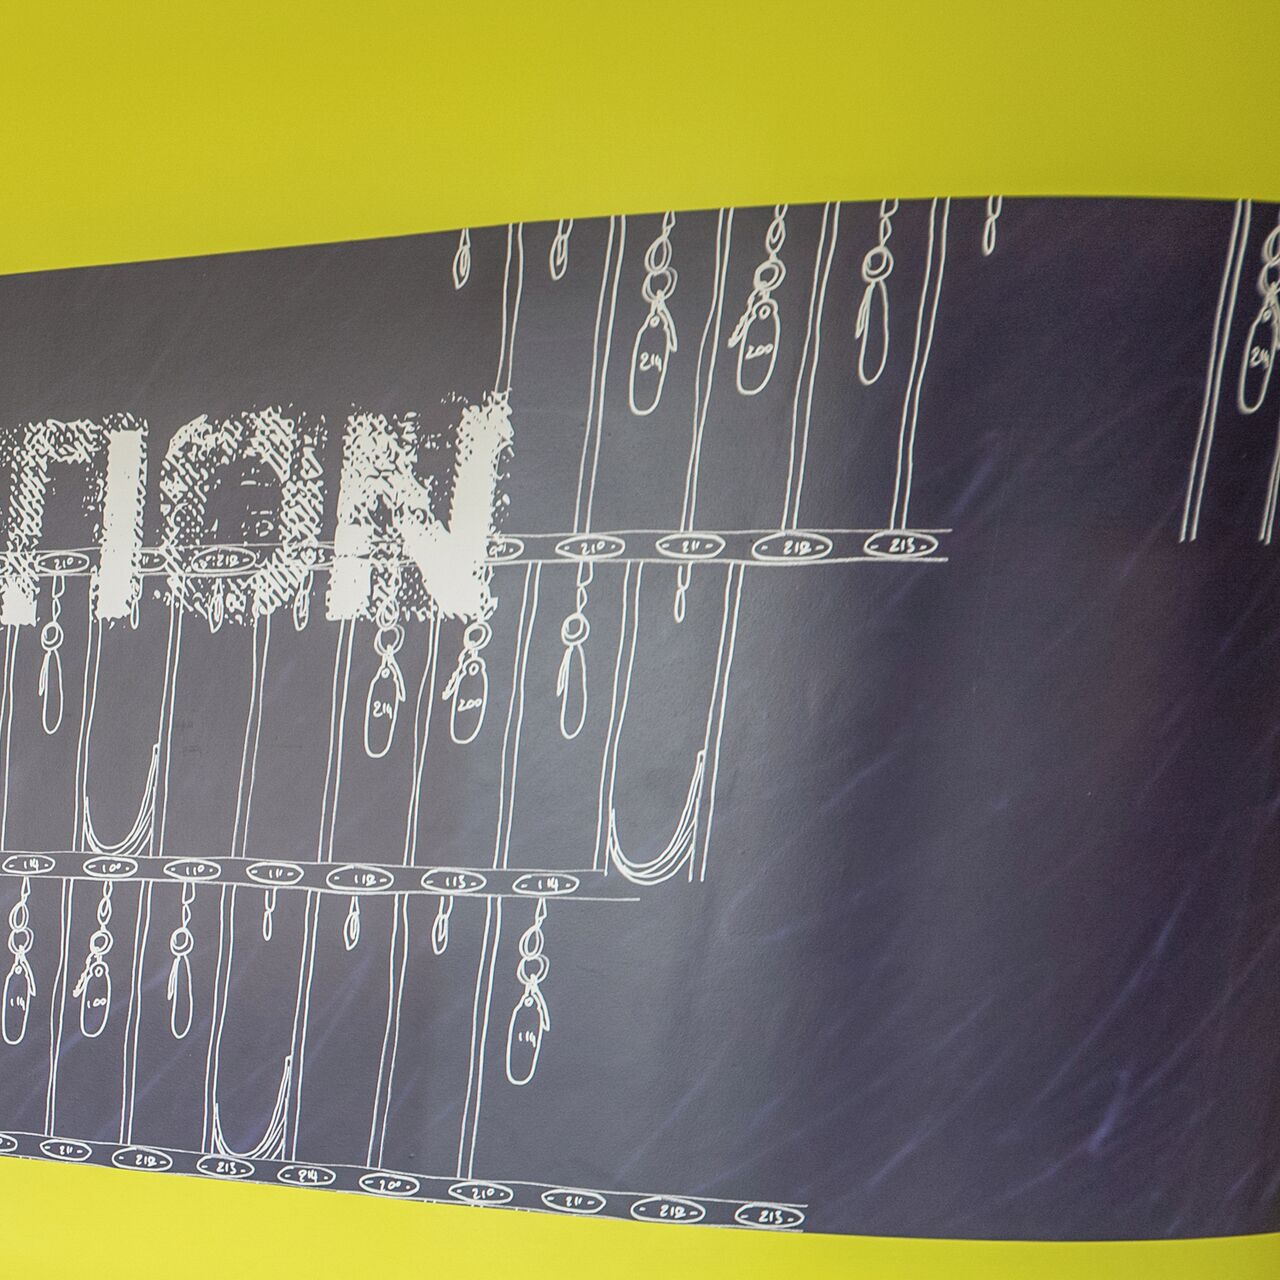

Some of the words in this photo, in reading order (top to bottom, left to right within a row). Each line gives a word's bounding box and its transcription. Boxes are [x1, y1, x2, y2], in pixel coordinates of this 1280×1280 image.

[744, 343, 773, 360] 200
[639, 351, 662, 372] 214
[54, 557, 74, 569] 210
[581, 541, 606, 554] 210
[682, 540, 700, 553] 211
[373, 701, 393, 719] 214
[458, 698, 483, 712] 200
[24, 858, 39, 871] 114
[186, 865, 205, 876] 110
[269, 869, 283, 879] 111
[538, 877, 559, 891] 114
[10, 996, 25, 1011] 114
[87, 997, 107, 1009] 100
[519, 1031, 536, 1048] 114
[59, 1146, 73, 1155] 211
[298, 1169, 319, 1184] 214
[472, 1188, 496, 1200] 210
[565, 1196, 583, 1208] 211
